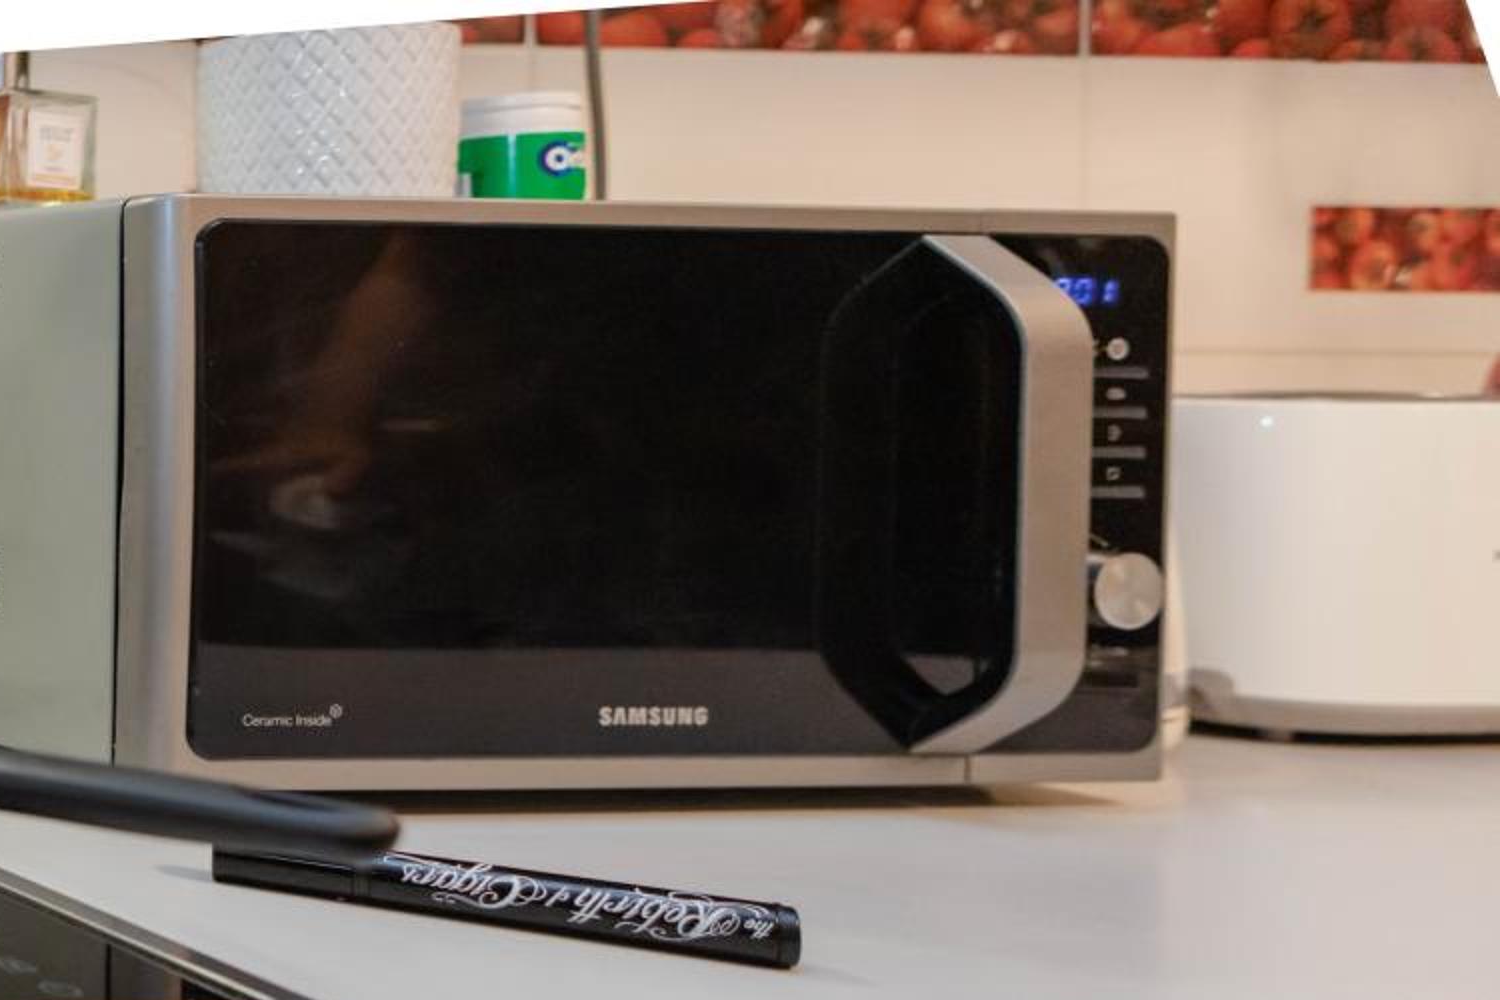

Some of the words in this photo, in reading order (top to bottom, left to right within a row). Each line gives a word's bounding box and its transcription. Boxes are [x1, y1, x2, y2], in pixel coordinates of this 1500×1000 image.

[242, 712, 294, 727] Ceramic
[295, 712, 332, 727] Inside
[598, 706, 709, 726] SAMSUNG
[401, 862, 547, 910] Cigars
[568, 889, 741, 942] Rebirth
[743, 917, 775, 939] the
